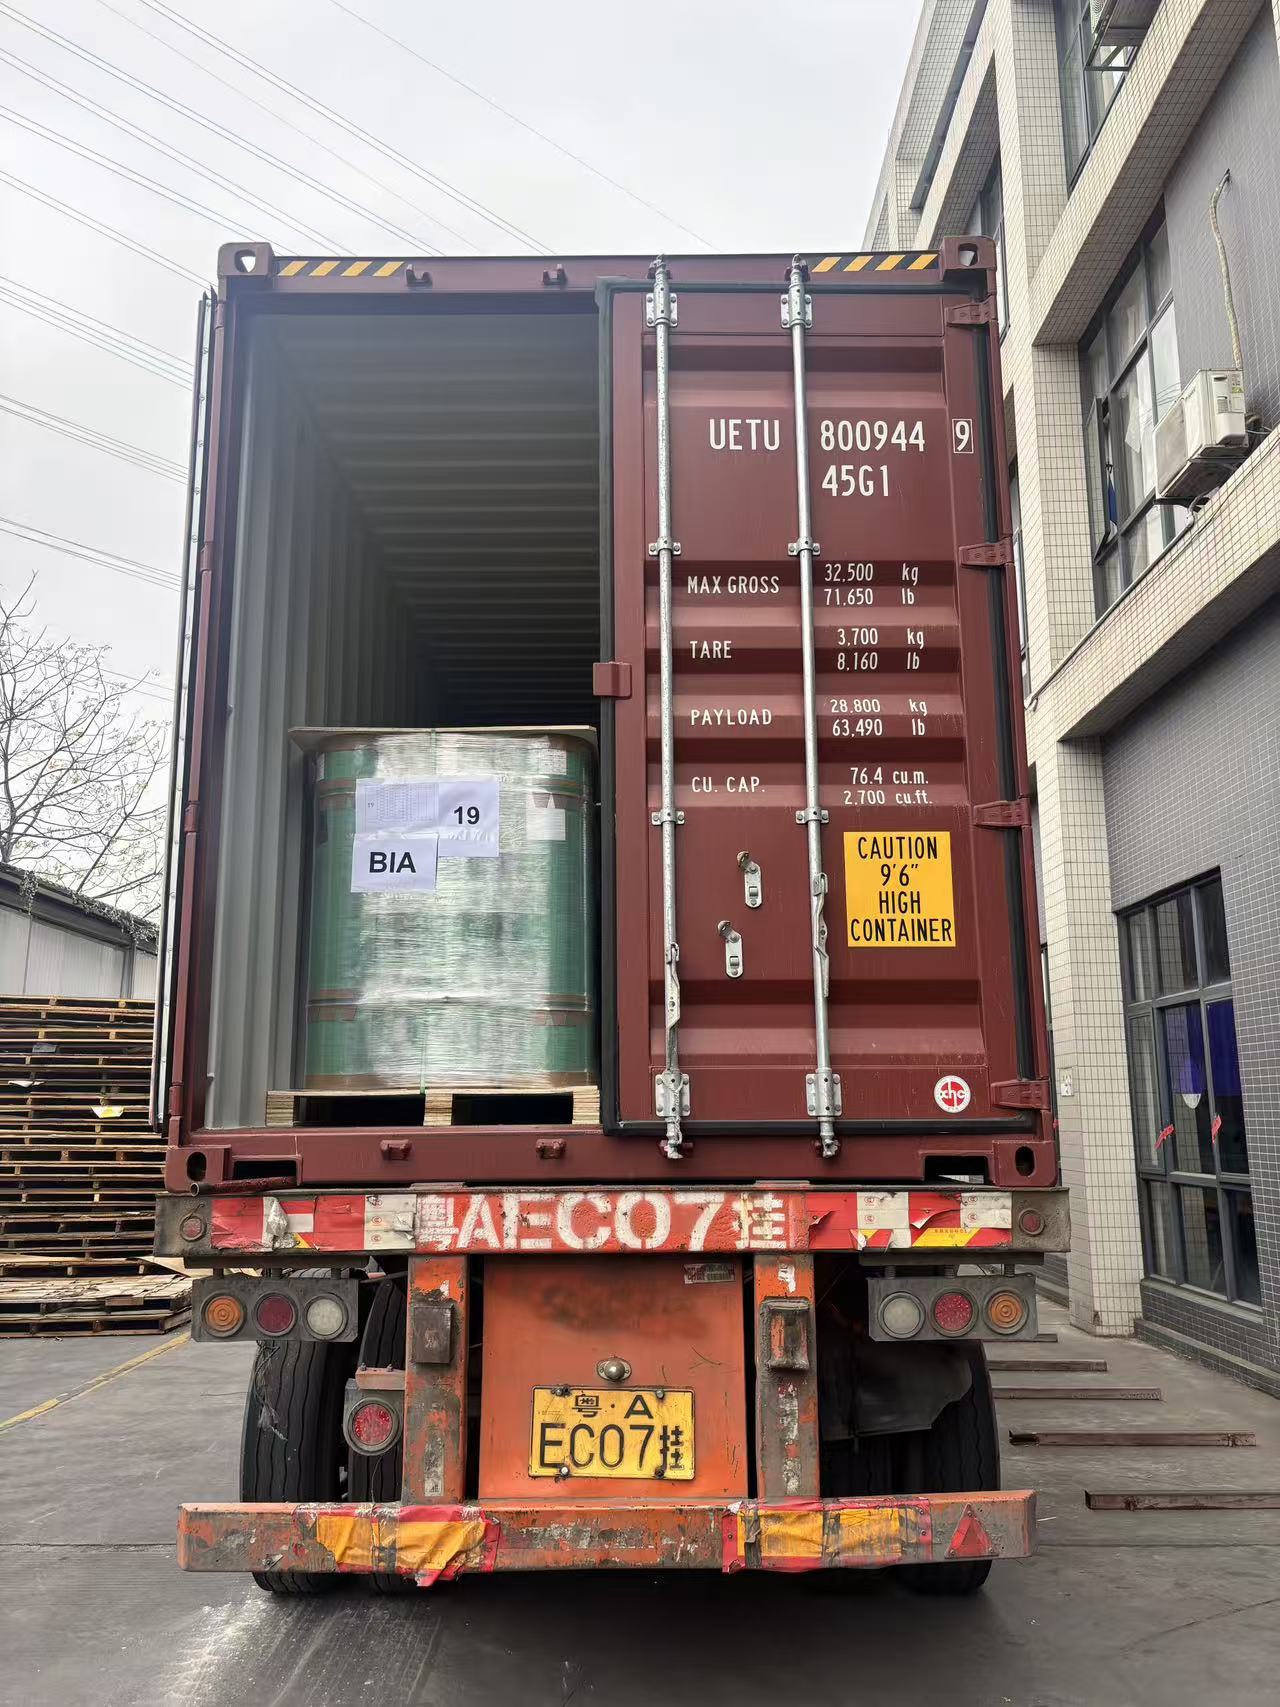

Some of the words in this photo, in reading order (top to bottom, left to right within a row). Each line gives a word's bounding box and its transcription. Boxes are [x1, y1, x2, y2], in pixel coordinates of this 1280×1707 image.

[709, 418, 780, 451] UETU
[820, 419, 926, 452] 800944
[955, 420, 971, 452] 9
[821, 464, 889, 497] 45G1
[901, 562, 919, 586] kg
[687, 575, 722, 594] MAX
[727, 575, 780, 594] GROSS
[901, 587, 915, 605] lb
[837, 627, 879, 647] 3,700
[906, 627, 925, 650] kg
[689, 640, 732, 659] TARE
[906, 651, 920, 670] lb
[690, 708, 772, 726] PAYLOAD
[908, 698, 928, 717] kg
[911, 718, 926, 736] lb
[691, 776, 718, 793] CU.
[726, 776, 766, 793] CAP.
[850, 766, 883, 785] 76.4
[892, 770, 929, 785] cu.m.
[895, 788, 933, 806] cu.ft.
[453, 806, 480, 825] 19
[857, 836, 938, 860] CAUTION
[368, 851, 417, 874] BIA
[878, 890, 921, 914] HIGH
[849, 917, 952, 943] CONTAINER
